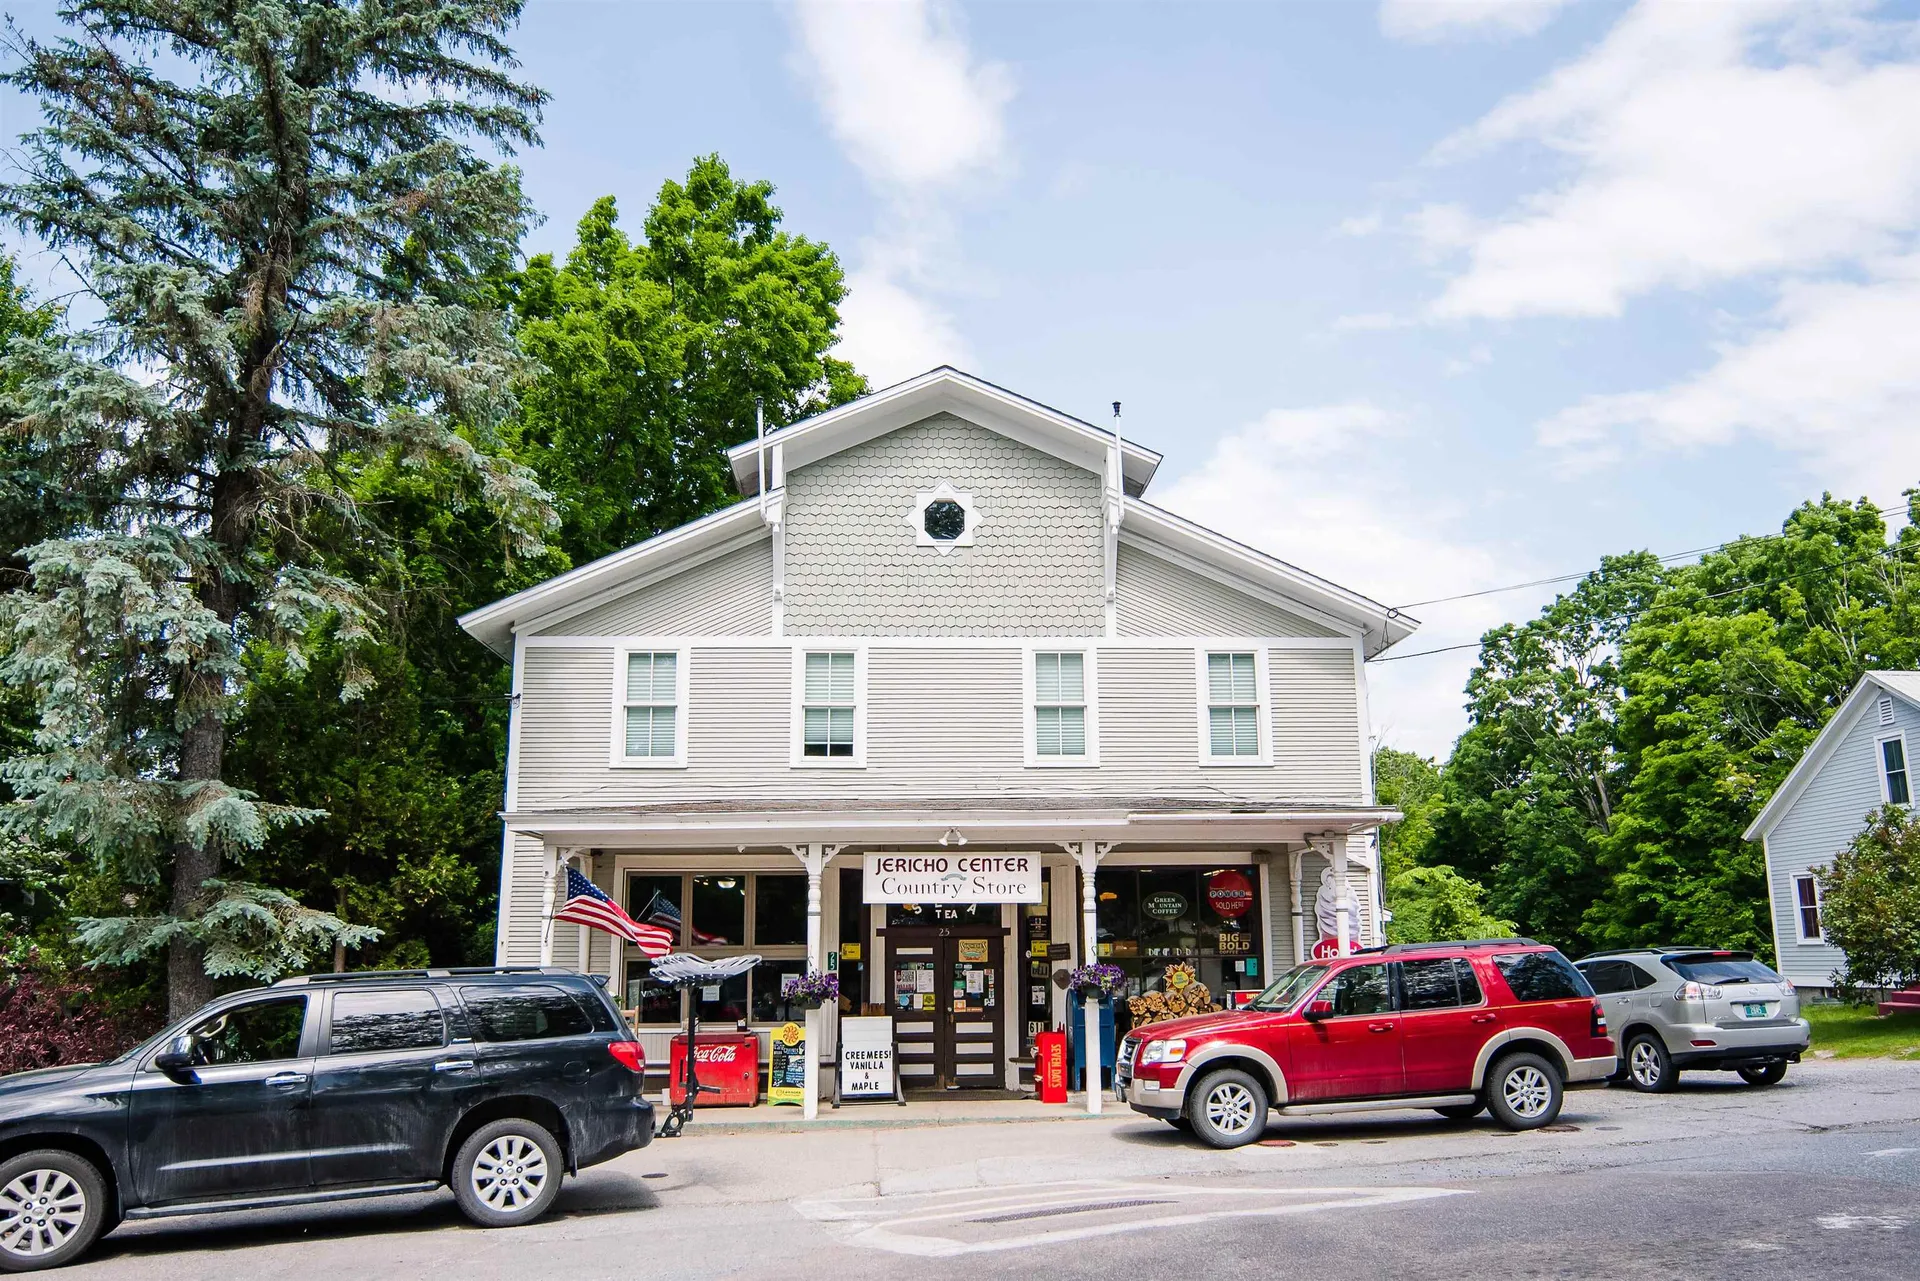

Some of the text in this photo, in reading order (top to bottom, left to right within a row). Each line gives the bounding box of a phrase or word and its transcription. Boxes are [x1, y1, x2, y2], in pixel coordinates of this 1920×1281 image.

[875, 857, 1029, 875] JERICHO CENTER
[881, 876, 1027, 899] Country Store
[1215, 901, 1231, 910] SOLD
[935, 909, 958, 919] TEA
[938, 927, 950, 937] 25
[1219, 933, 1240, 942] BIG
[1219, 942, 1250, 950] BOLD
[850, 1061, 884, 1070] VANILLA
[1051, 1044, 1062, 1088] SEVEN DAYS
[864, 1071, 869, 1080] &
[851, 1081, 879, 1091] MAPLE
